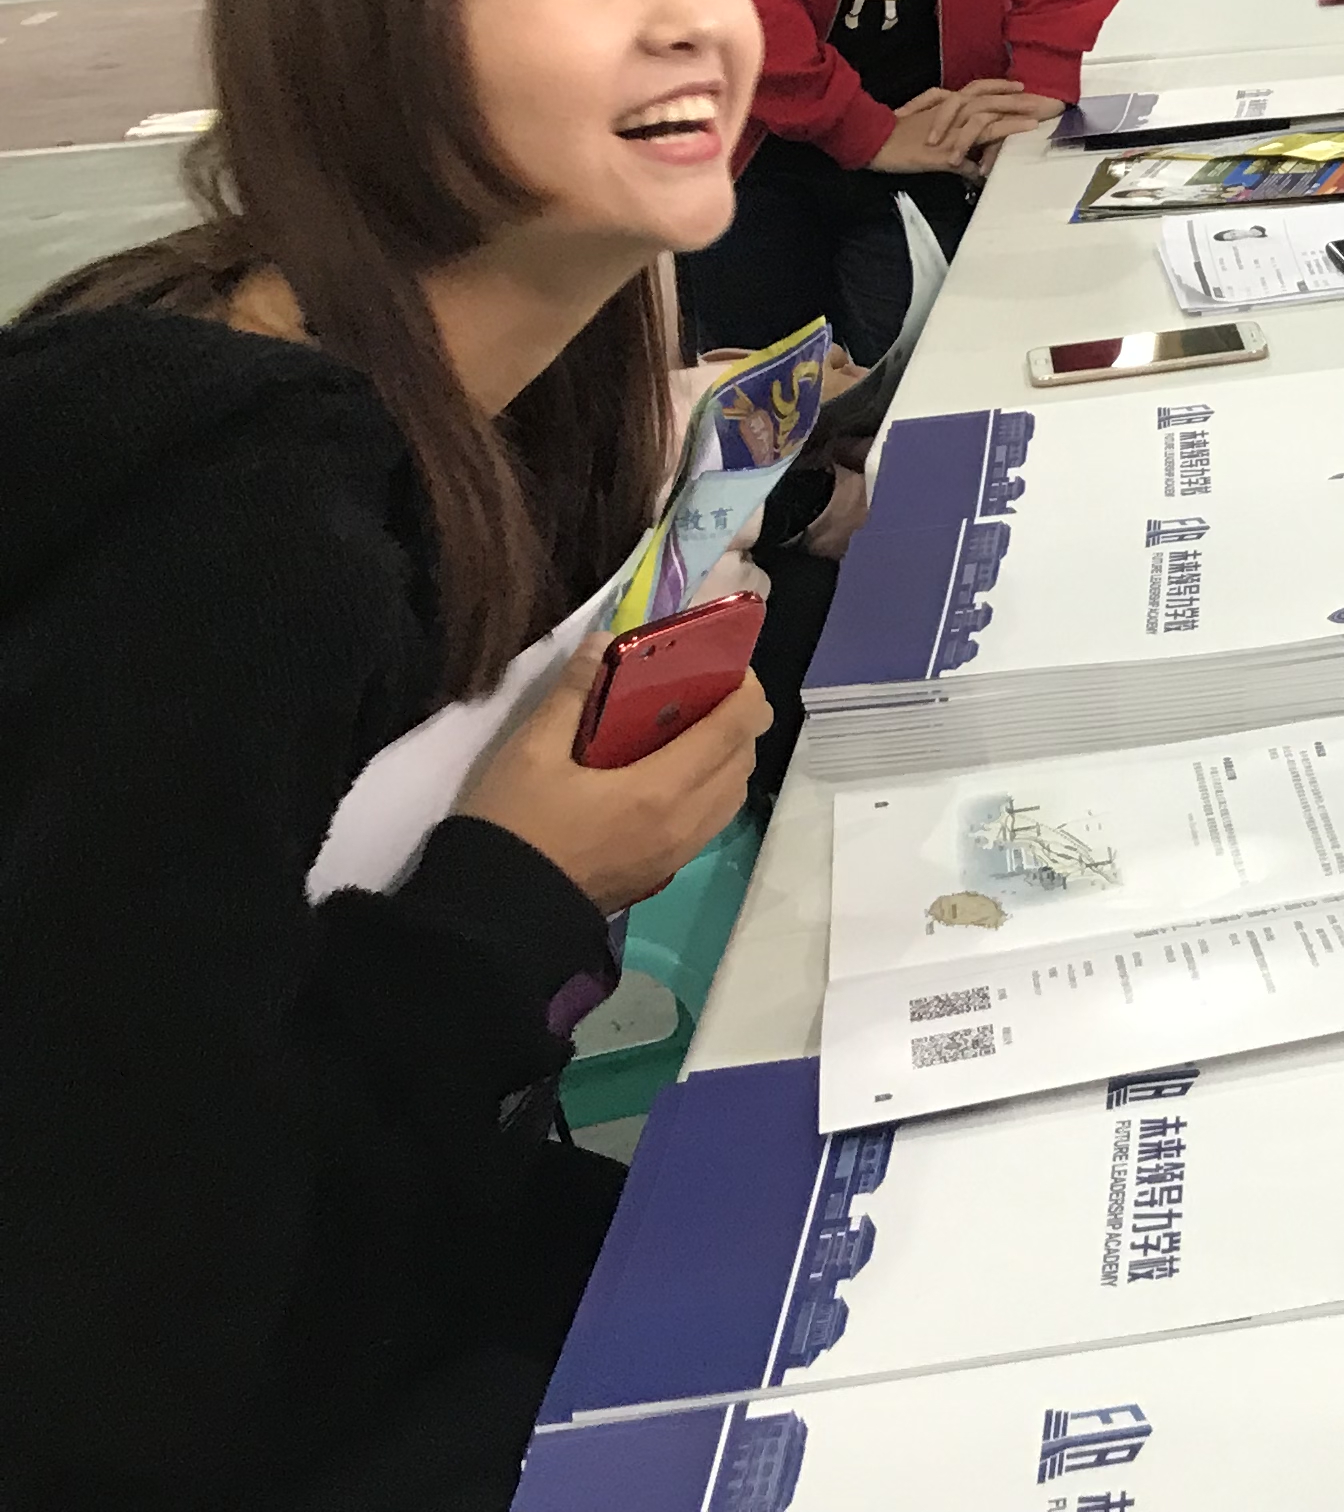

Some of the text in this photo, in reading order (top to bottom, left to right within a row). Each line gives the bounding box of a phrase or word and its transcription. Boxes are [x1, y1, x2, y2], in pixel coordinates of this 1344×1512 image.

[1179, 429, 1213, 498] 未来领导力学校
[675, 507, 734, 531] 教育
[1162, 549, 1203, 635] 未来领导力学校
[1100, 1120, 1132, 1288] FUTURE LEADERSHIP ACADEMY
[1126, 1115, 1188, 1284] 未来领导力学校
